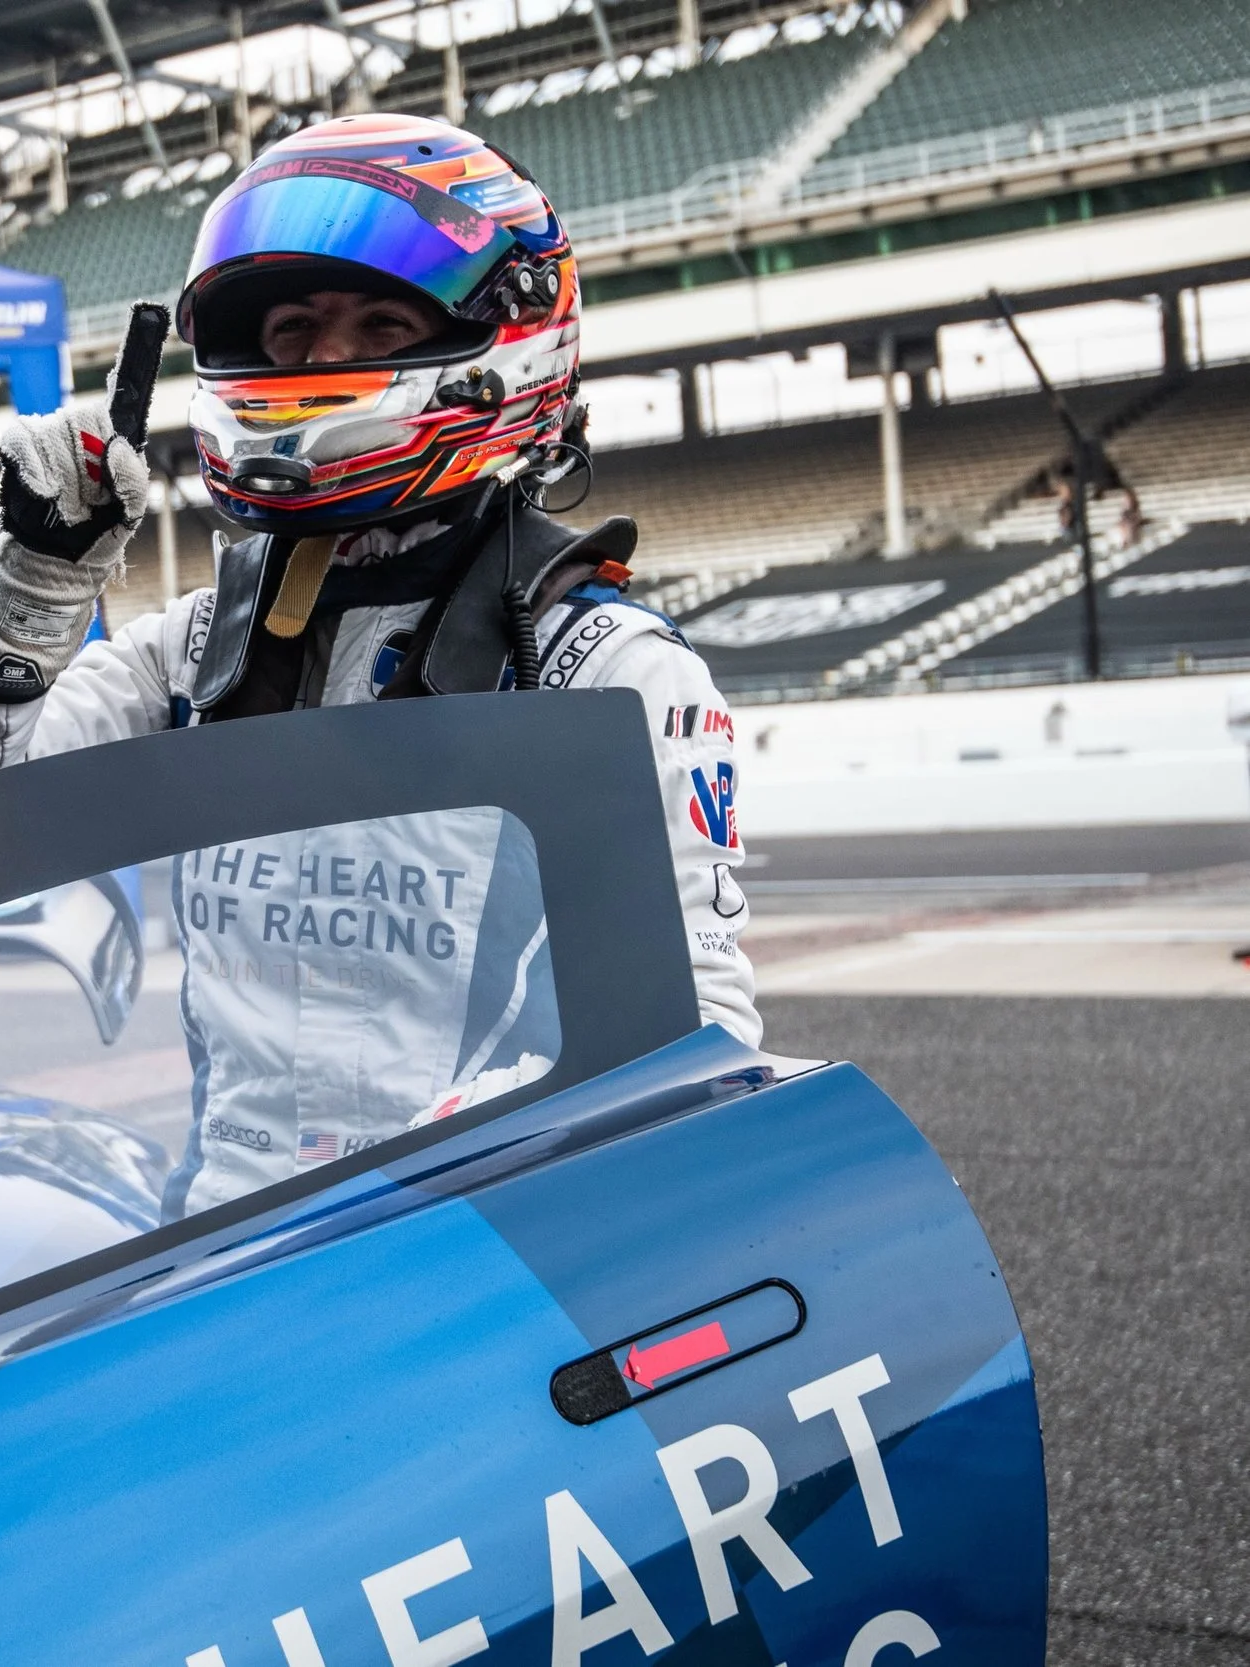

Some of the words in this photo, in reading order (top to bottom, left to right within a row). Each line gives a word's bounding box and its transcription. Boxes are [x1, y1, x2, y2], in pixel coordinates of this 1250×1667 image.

[3, 668, 26, 677] OMP
[543, 615, 614, 688] parco
[690, 761, 734, 847] VP
[299, 853, 465, 910] HEART
[191, 892, 239, 934] OF
[262, 902, 456, 961] RACING
[695, 931, 723, 942] THE
[202, 956, 262, 984] JOIN
